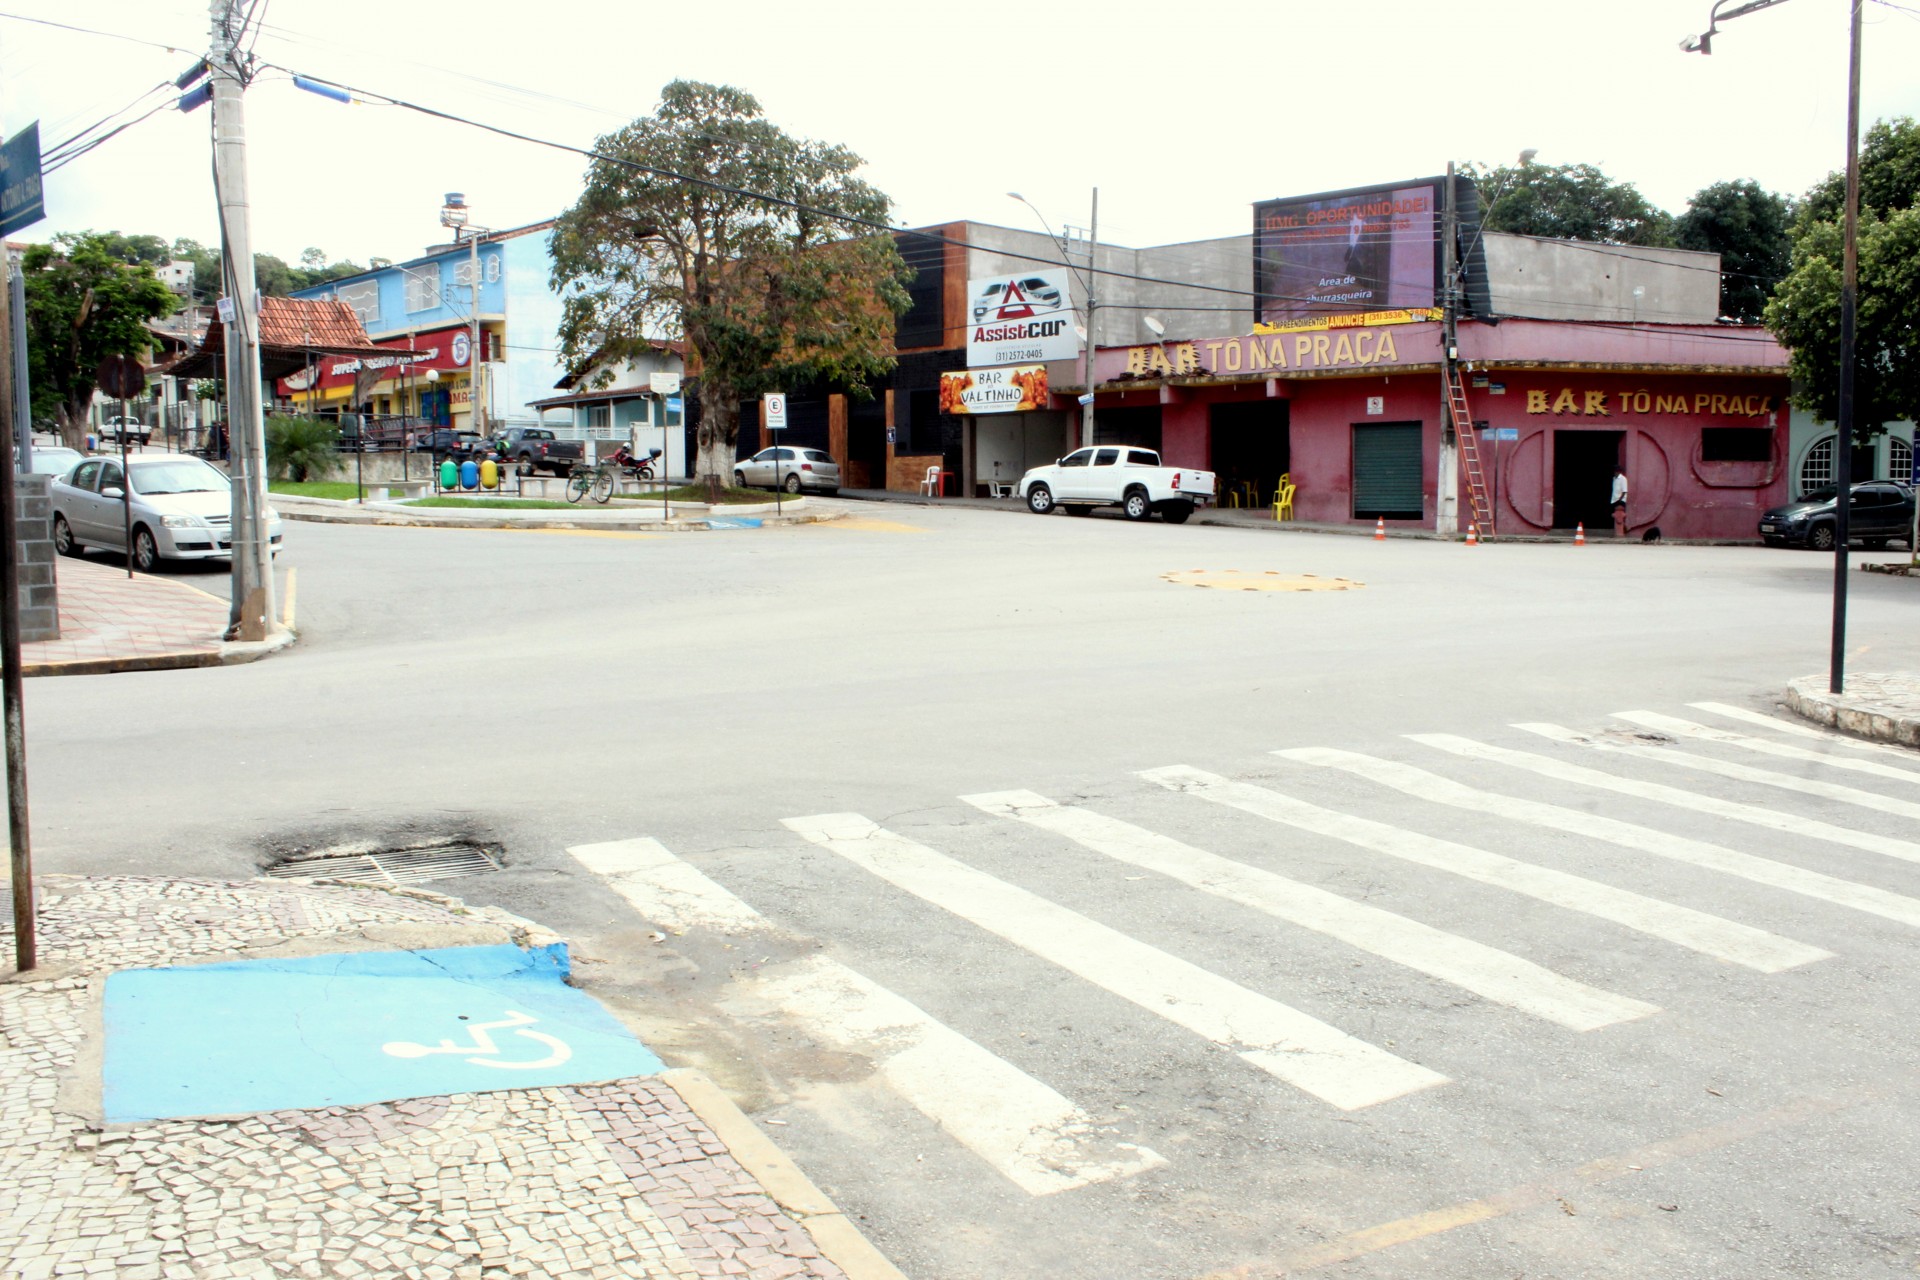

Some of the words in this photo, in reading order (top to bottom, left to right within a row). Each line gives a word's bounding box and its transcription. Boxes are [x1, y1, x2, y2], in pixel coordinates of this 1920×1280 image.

[1306, 196, 1429, 226] OPORTUNIDADE!
[1343, 275, 1356, 285] de
[1272, 316, 1327, 330] EMPREENDIMENTOS
[1330, 314, 1364, 329] ANUNCIE
[1383, 311, 1403, 320] 3536
[995, 351, 1008, 362] (31)
[1009, 349, 1043, 360] 2572-0405
[1127, 342, 1201, 375] BAR
[1207, 339, 1243, 372] TÔ
[1250, 337, 1289, 370] NA
[1296, 330, 1399, 367] PRAÇA
[979, 371, 1002, 385] BAR
[961, 388, 1022, 403] VALTINHO
[1526, 387, 1611, 416] BAR
[1618, 388, 1651, 414] TÔ
[1655, 395, 1690, 414] NA
[772, 401, 778, 410] E
